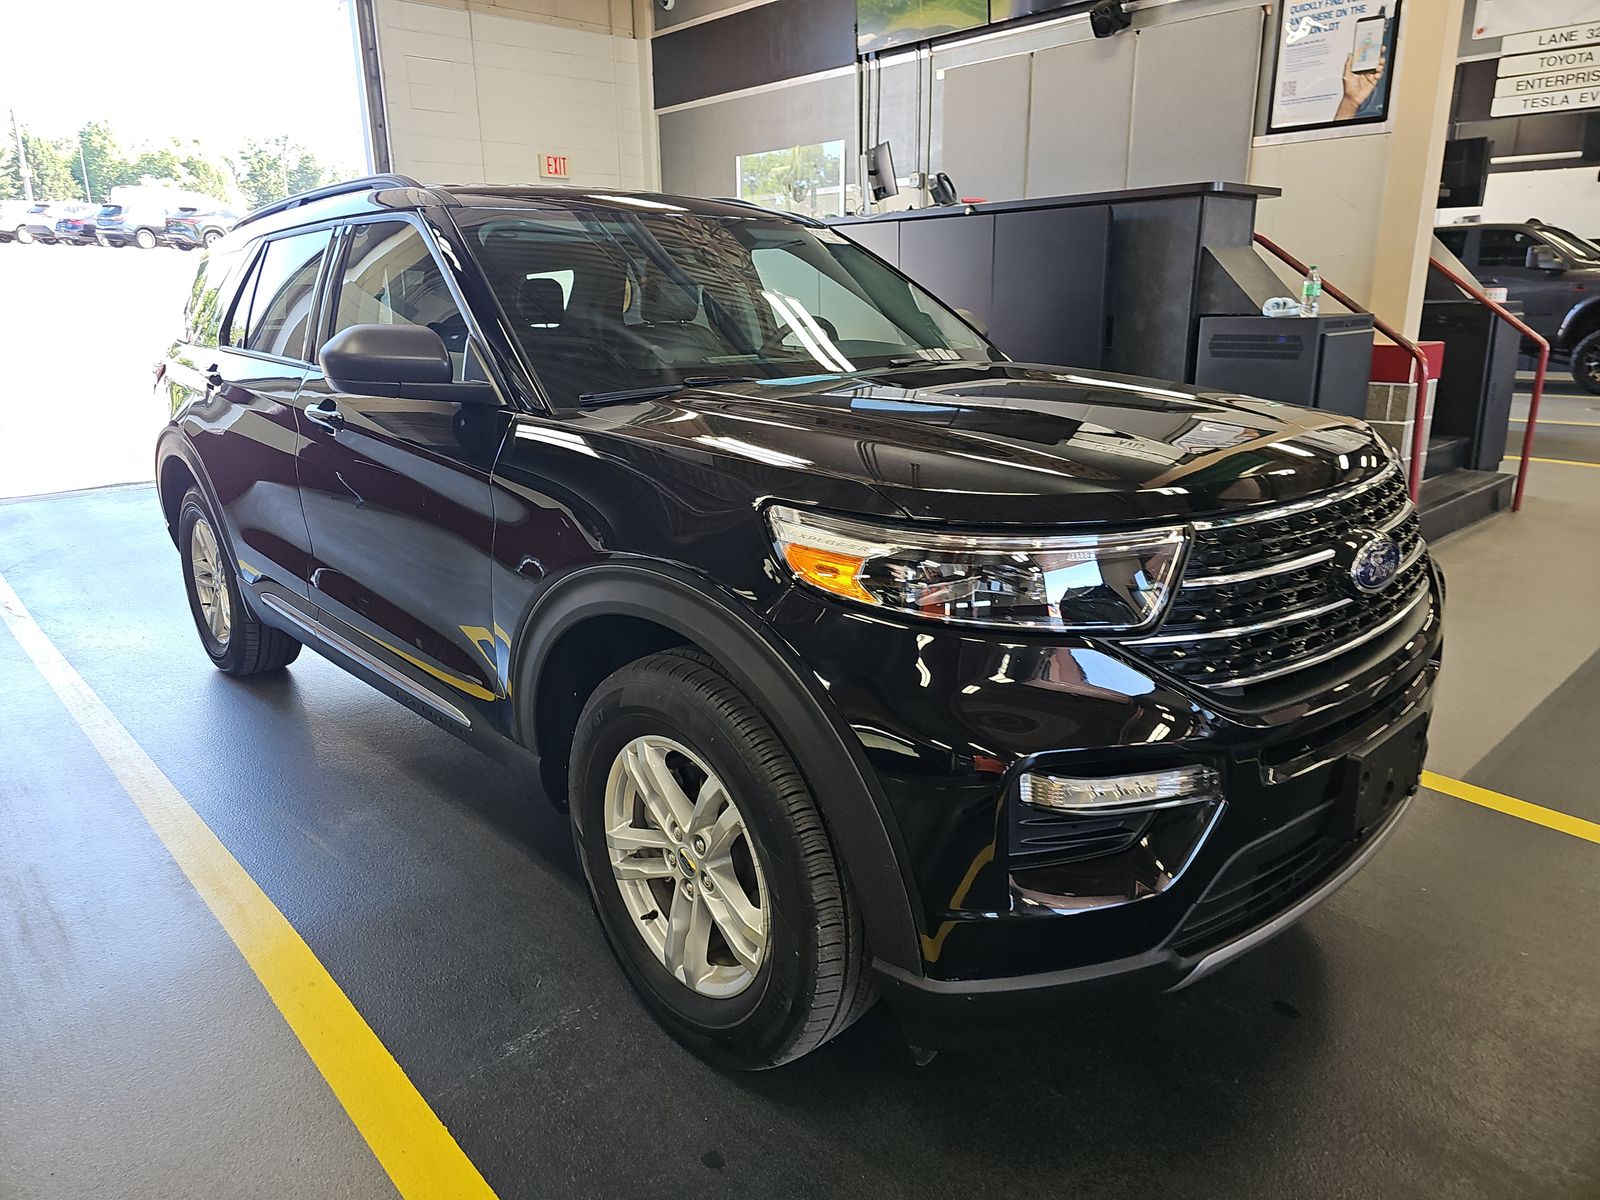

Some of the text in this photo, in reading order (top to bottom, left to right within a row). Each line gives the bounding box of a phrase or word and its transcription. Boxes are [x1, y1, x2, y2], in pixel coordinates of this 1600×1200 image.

[1290, 1, 1321, 14] QUICKLY
[1290, 4, 1366, 25] ANHERE ON THE
[1538, 30, 1579, 46] LANE
[1538, 51, 1594, 67] TOYOTA
[1521, 91, 1600, 109] TESLA EV
[546, 156, 567, 175] EXIT
